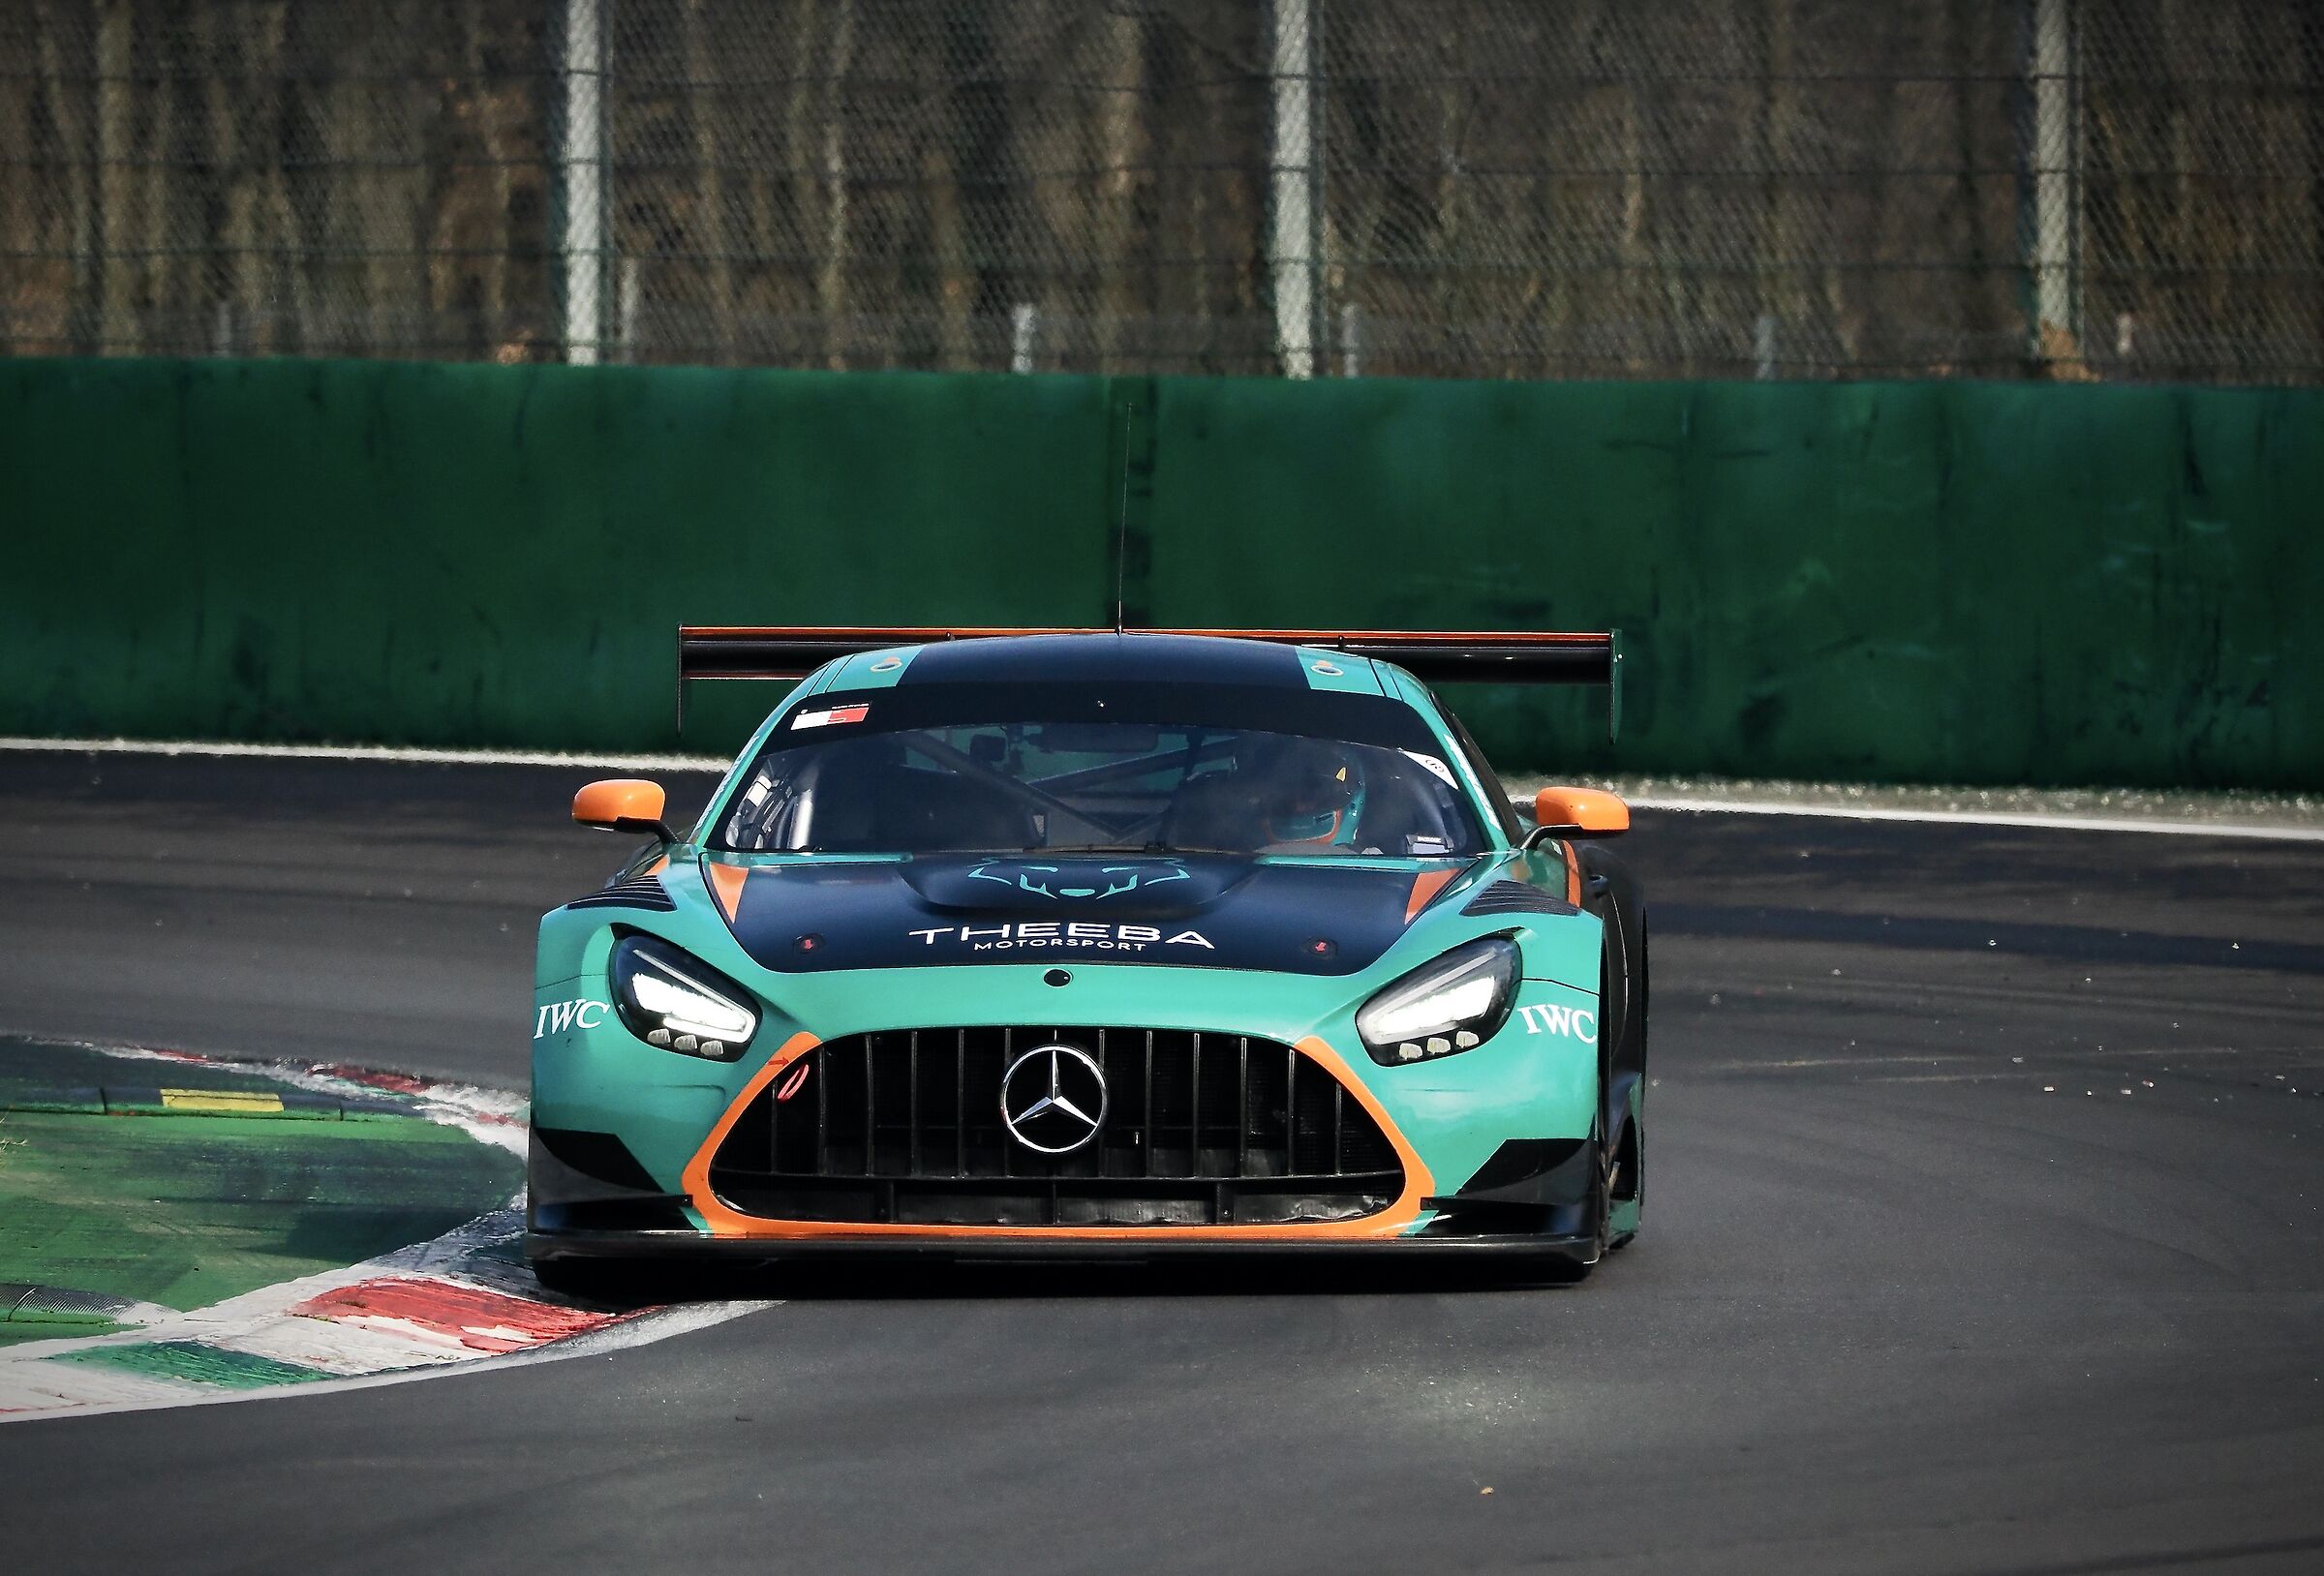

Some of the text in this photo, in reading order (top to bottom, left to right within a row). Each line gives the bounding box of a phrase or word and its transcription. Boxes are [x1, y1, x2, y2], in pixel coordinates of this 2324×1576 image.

[908, 922, 1215, 950] THEEBA
[973, 938, 1147, 952] MOTORSPORT
[534, 998, 611, 1040] IWC
[1516, 1004, 1598, 1044] IWC
